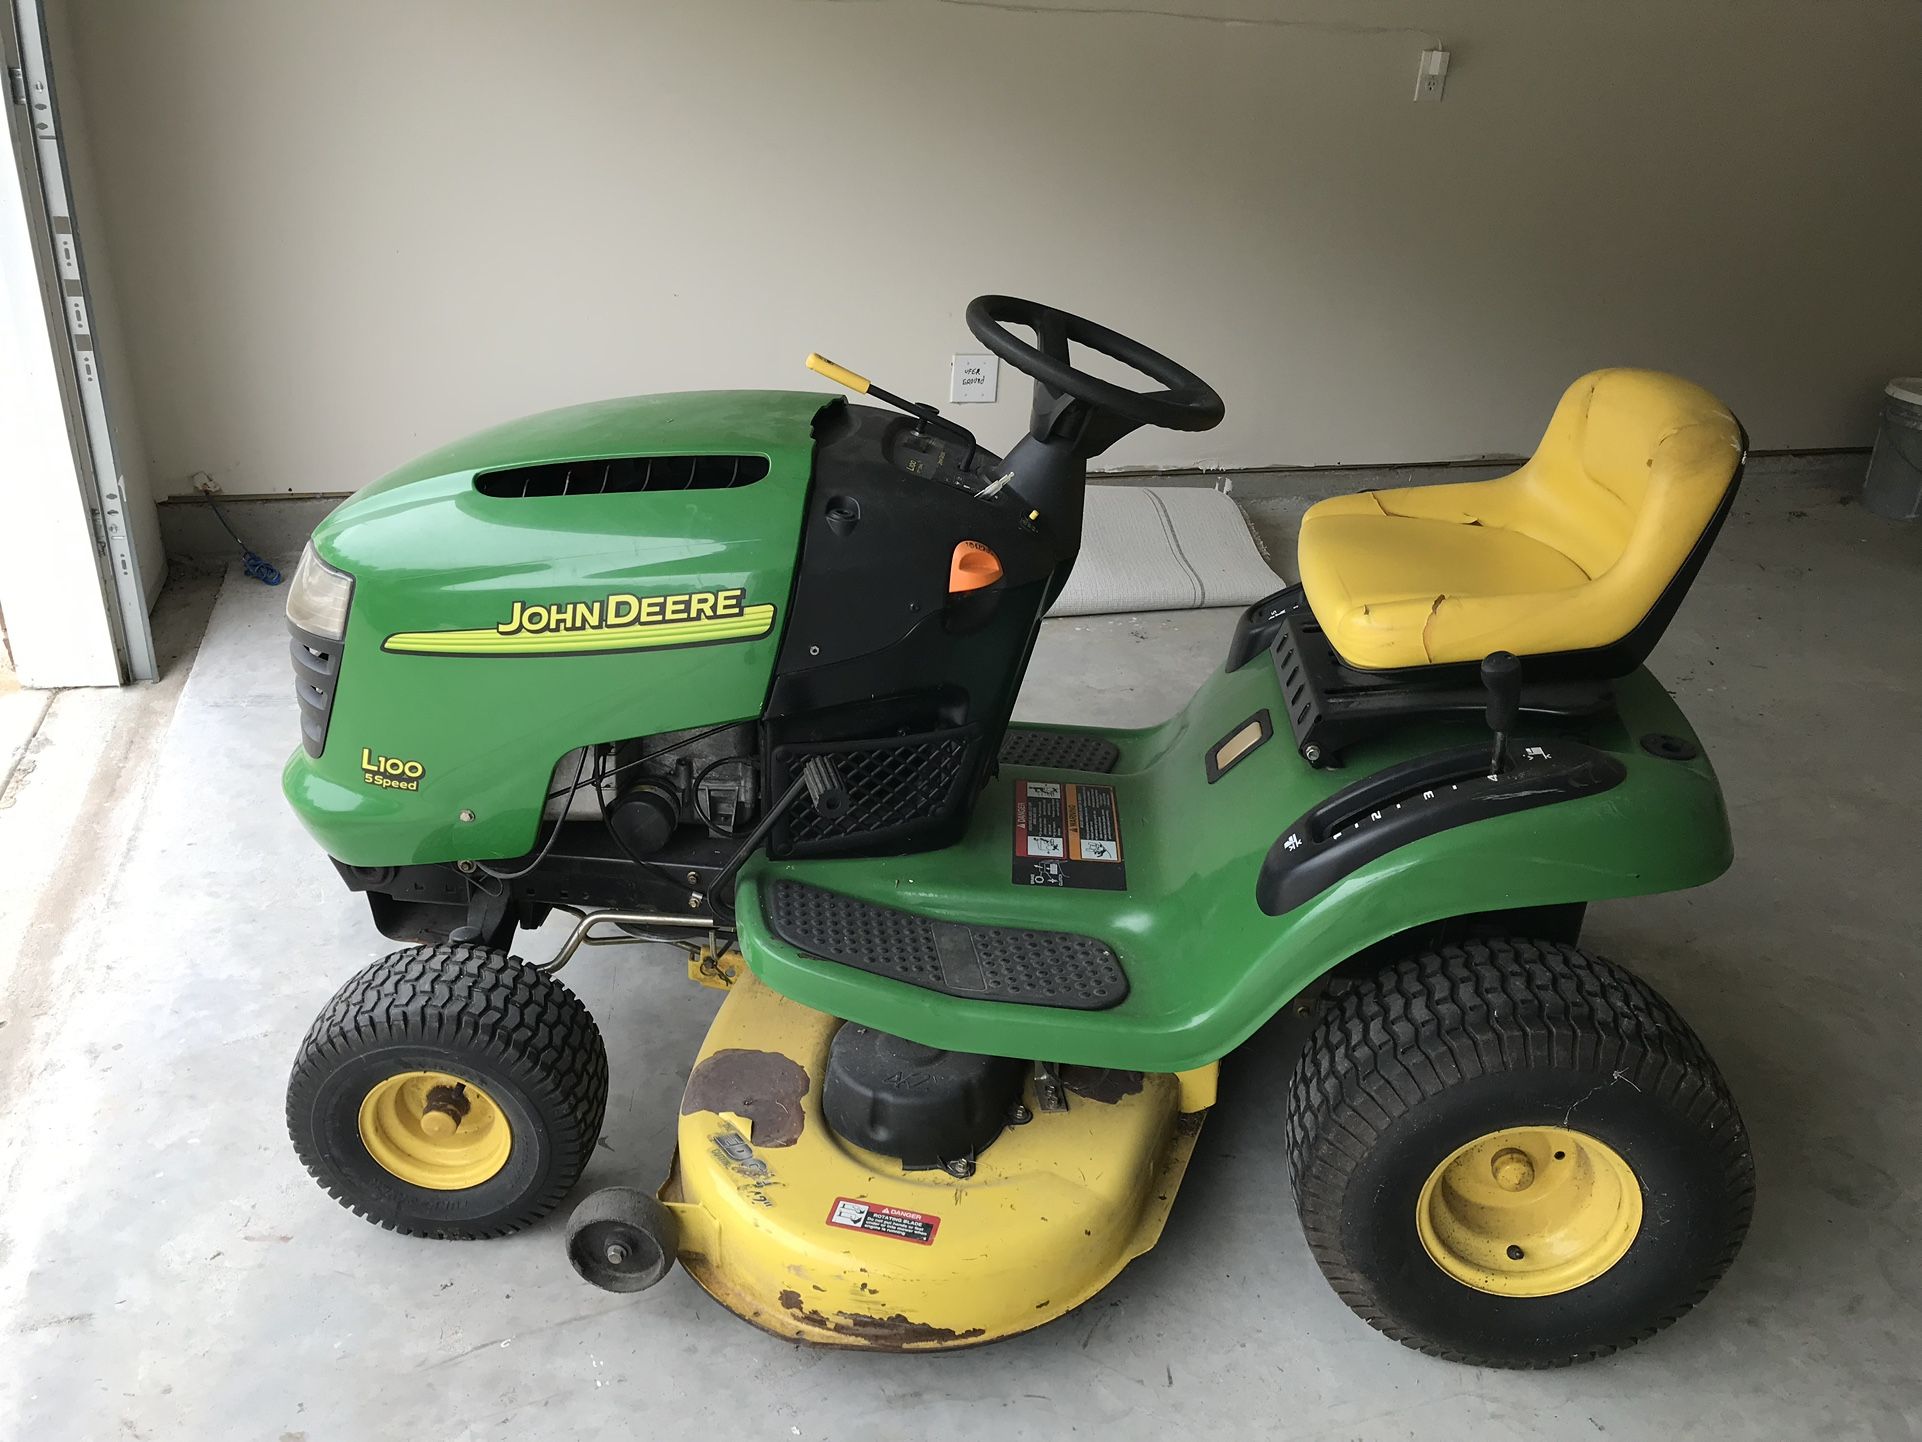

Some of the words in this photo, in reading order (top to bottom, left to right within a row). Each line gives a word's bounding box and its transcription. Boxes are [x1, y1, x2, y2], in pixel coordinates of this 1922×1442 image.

[497, 600, 603, 636] JOHN
[605, 588, 746, 628] DEERE
[361, 747, 424, 778] L100
[365, 773, 374, 783] 5
[374, 775, 418, 791] Speed
[1487, 774, 1498, 782] 4
[1423, 790, 1435, 800] 3
[1017, 802, 1026, 822] DANGER
[1371, 810, 1382, 821] 2
[873, 1213, 903, 1223] ROTATING
[903, 1219, 923, 1227] BLADE
[891, 1209, 922, 1220] DANGER
